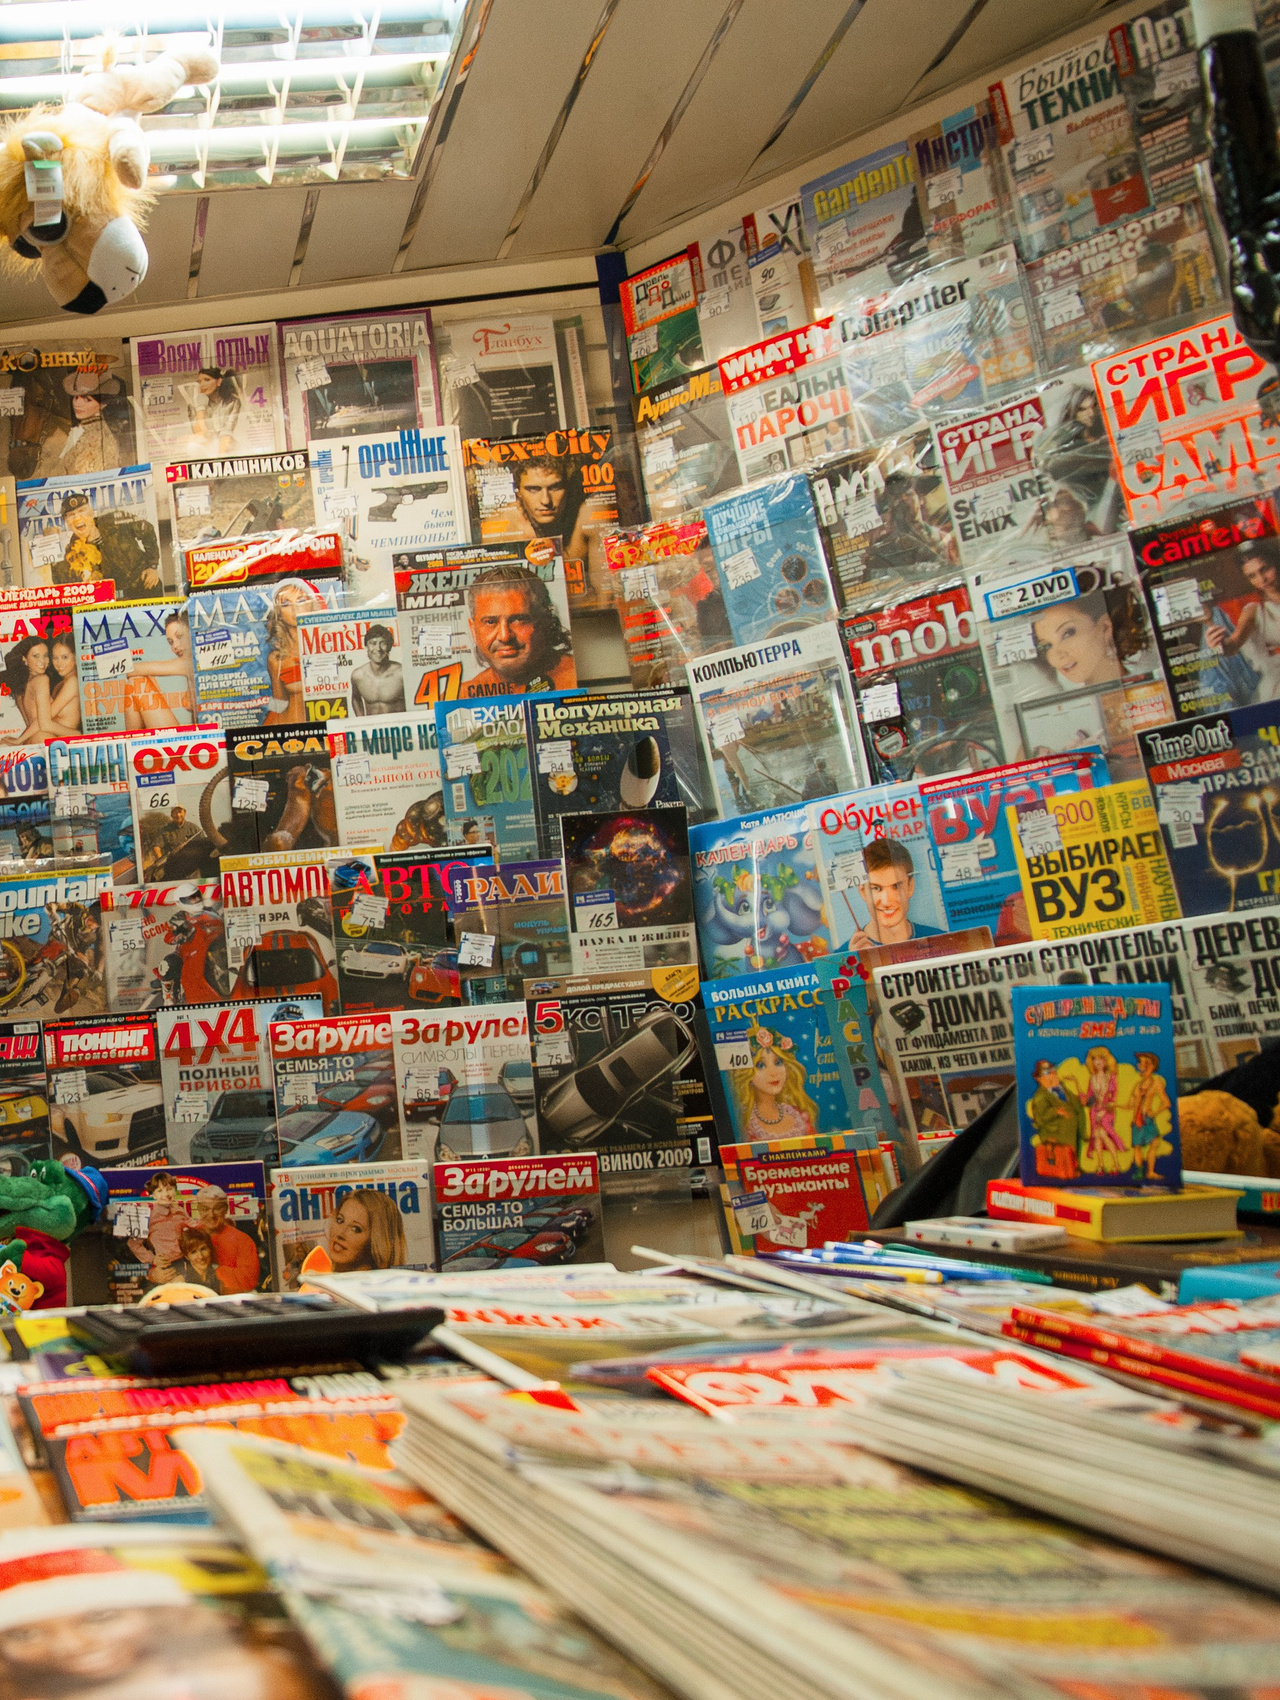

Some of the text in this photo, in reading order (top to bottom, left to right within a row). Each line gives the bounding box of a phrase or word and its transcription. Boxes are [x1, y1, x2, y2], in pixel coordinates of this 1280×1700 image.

[840, 274, 971, 343] Computer
[284, 319, 430, 360] AQUATORIA
[472, 324, 544, 356] Главбух
[0, 350, 97, 372] КОННЫЙ
[722, 338, 795, 380] WHAT
[942, 404, 1042, 448] СТРАНА
[545, 428, 611, 459] City
[191, 454, 306, 480] КАЛАШНИКОВ
[582, 462, 614, 485] 100
[430, 508, 454, 519] Чем
[712, 496, 768, 529] ЛУЧШИЕ
[424, 520, 454, 532] бьют
[960, 513, 1018, 542] ENIX
[370, 531, 457, 549] ЧЕМПИОНЫ?
[715, 523, 771, 557] ИГРЫ
[1142, 517, 1264, 567] Camera
[416, 553, 443, 562] OLYMPIA
[64, 584, 94, 597] 2009
[1018, 575, 1070, 602] 2 DVD
[20, 599, 51, 610] ДЕВУШКИ
[63, 594, 95, 605] ПОДАРОК
[406, 592, 460, 610] МИР
[304, 614, 355, 624] СУПЕРКОМПЛЕКС
[410, 611, 464, 624] ТРЕНИНГ
[692, 639, 801, 684] КОМПЬЮТЕРРА
[198, 672, 247, 683] ПРОВЕРКА
[198, 677, 263, 691] ДЛЯ КРЕПКИХ
[305, 699, 347, 722] 104
[535, 696, 682, 722] Популярная
[538, 715, 660, 740] Механика
[1166, 757, 1225, 779] Москва
[150, 792, 170, 808] 66
[740, 817, 760, 831] Катя
[1054, 800, 1094, 827] 600
[695, 837, 798, 869] КАЛЕНДАРЬ
[1032, 868, 1125, 923] ВУЗ
[588, 912, 613, 928] 165
[1052, 914, 1142, 938] ТЕХНИЧЕСКИЕ
[580, 937, 624, 947] НАУКА
[566, 984, 590, 993] ДОЛОЙ
[711, 973, 819, 1002] БОЛЬШАЯ КНИГА
[929, 989, 1006, 1033] ДОМА
[60, 1029, 149, 1052] ТЮНИНГ
[896, 1029, 988, 1051] ОТ ФУНДАМЕНТА
[275, 1055, 355, 1072] СЕМЬЯ-ТО
[729, 1052, 748, 1066] 100
[953, 1051, 978, 1067] ЧЕГО
[991, 1048, 1012, 1063] КАК
[179, 1064, 260, 1081] ПОЛНЫЙ
[179, 1076, 262, 1092] ПРИВОД
[656, 1149, 693, 1166] 2009
[769, 1149, 827, 1161] НАКЛЕЙКАМИ
[744, 1160, 850, 1183] Бременские
[753, 1176, 849, 1198] музыканты
[441, 1201, 524, 1217] СЕМЬЯ-ТО
[442, 1214, 524, 1231] БОЛЬШАЯ
[751, 1216, 768, 1230] 40
